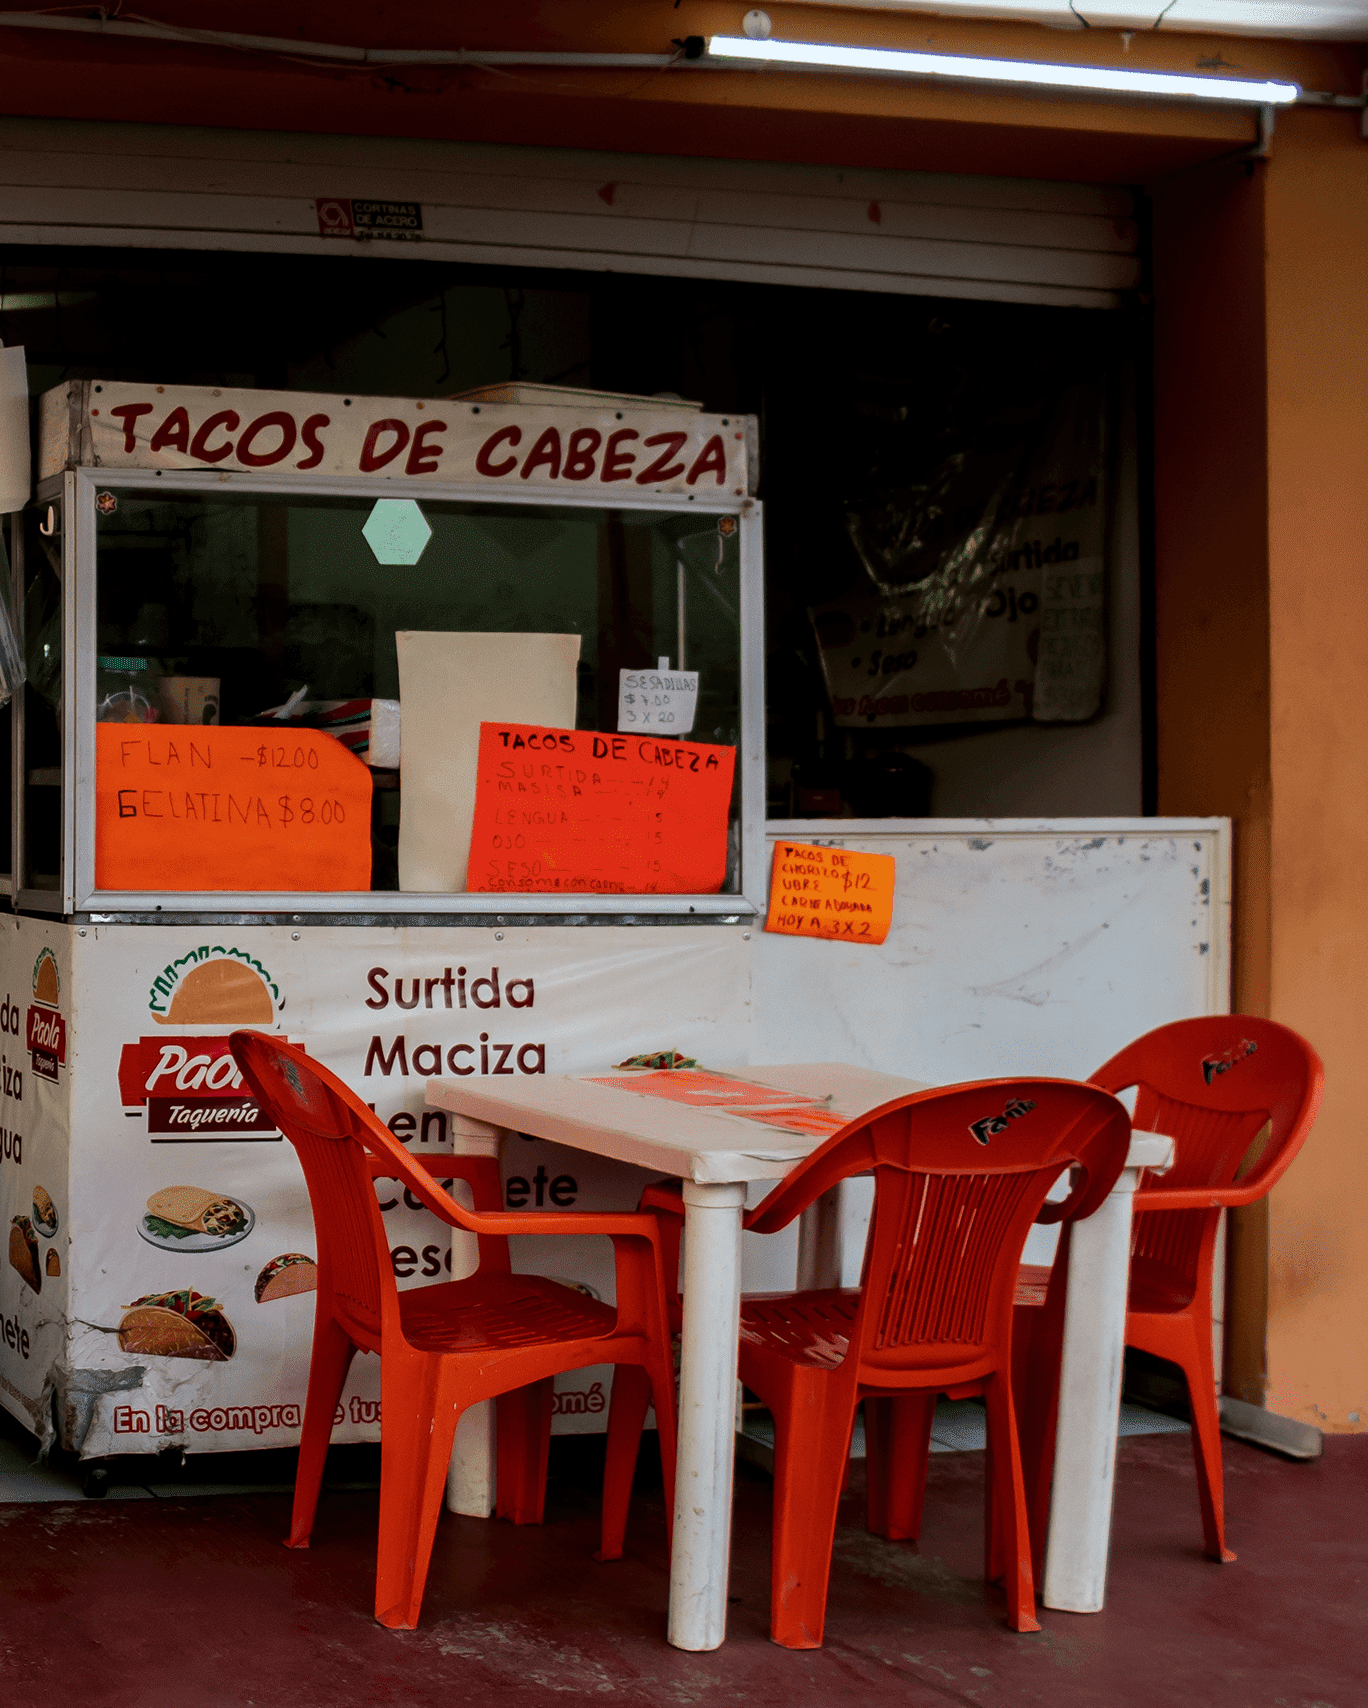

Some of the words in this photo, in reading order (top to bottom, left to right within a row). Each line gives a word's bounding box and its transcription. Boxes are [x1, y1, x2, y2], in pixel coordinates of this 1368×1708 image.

[354, 202, 418, 216] CORTINAS
[355, 213, 373, 225] DE
[375, 214, 419, 228] ACERO
[110, 402, 332, 471] TACOS
[358, 418, 449, 477] DE
[475, 425, 730, 487] CABEZA
[867, 650, 918, 676] Seso
[119, 739, 213, 769] FLAN
[497, 731, 575, 753] TACOS
[592, 736, 629, 761] DE
[638, 741, 720, 773] CABEZA
[495, 760, 602, 786] SURTIDA
[117, 789, 272, 828] GELATINA
[278, 794, 347, 828] $8.00
[494, 808, 569, 825] LENGUA
[492, 833, 527, 849] OJO
[486, 859, 543, 879] SESO
[785, 846, 824, 863] TACOS
[831, 854, 851, 868] DE
[782, 877, 822, 892] UBRE
[776, 913, 805, 930] HOY
[809, 915, 822, 930] A
[365, 965, 536, 1010] Surtida
[30, 1012, 61, 1050] Paola
[144, 1044, 244, 1091] Pao
[363, 1031, 547, 1078] Maciza
[168, 1102, 260, 1130] Taquería
[389, 1244, 452, 1279] es
[113, 1405, 151, 1434] En
[155, 1403, 185, 1434] la
[189, 1403, 302, 1435] compra
